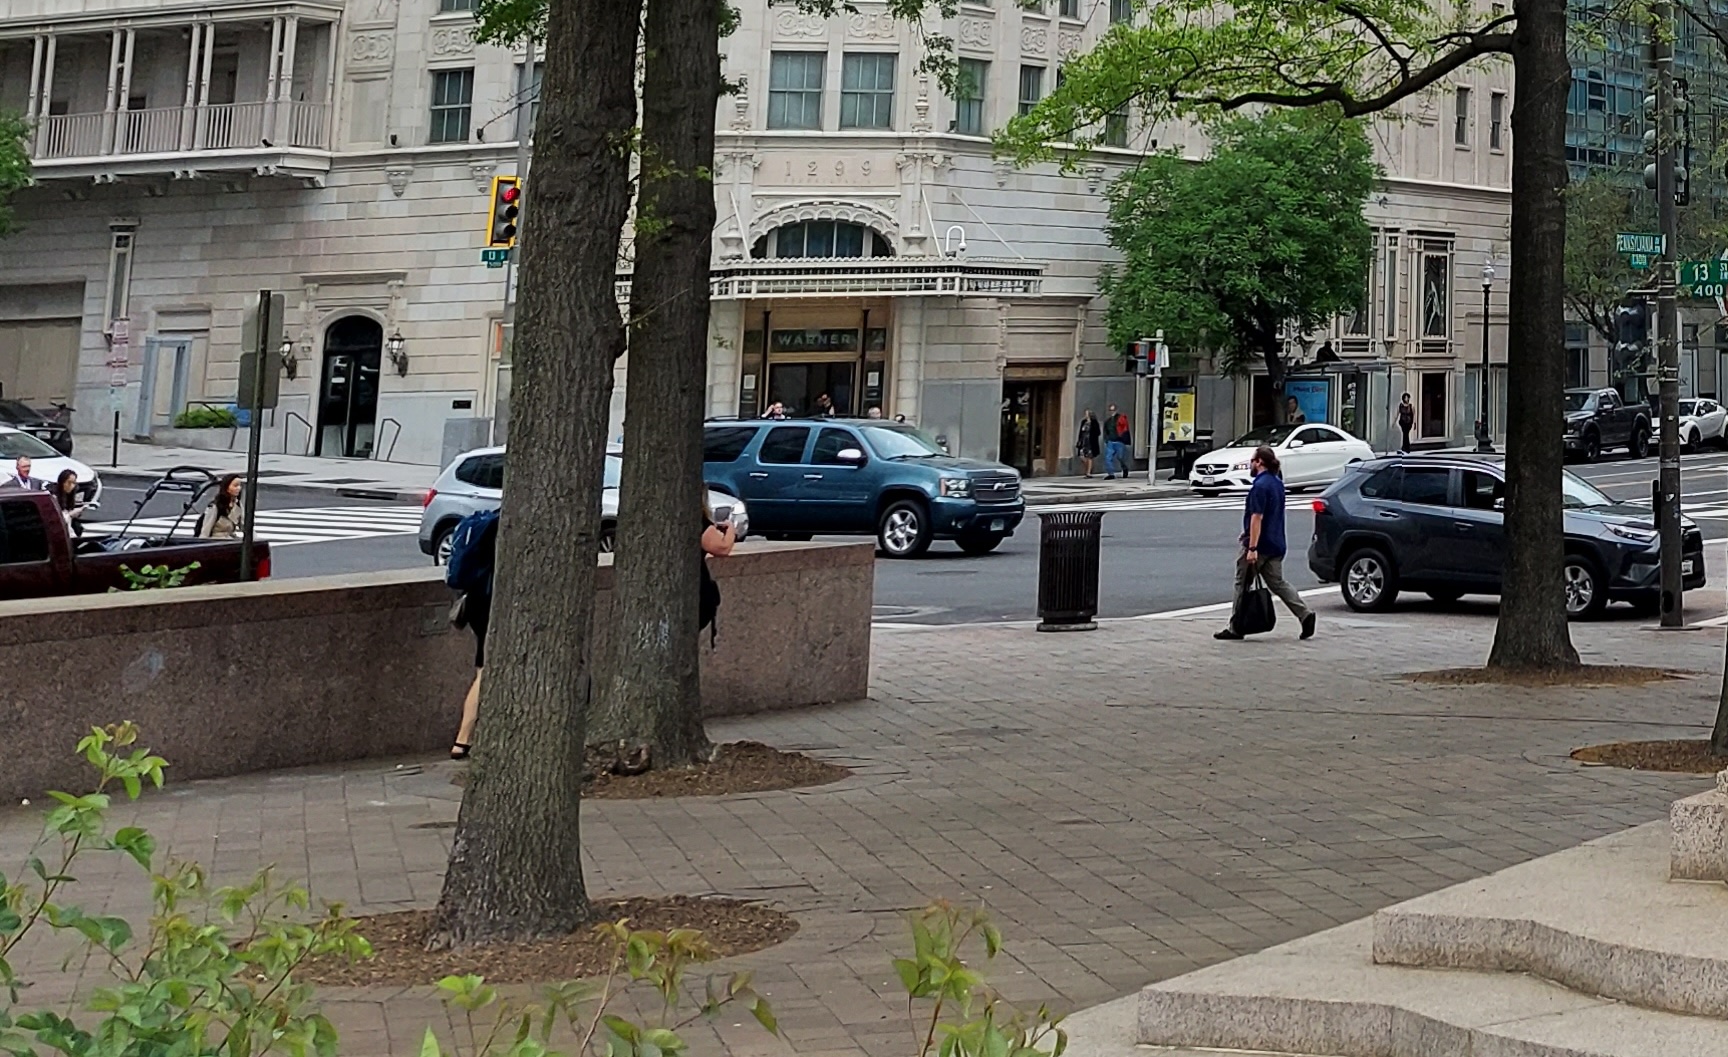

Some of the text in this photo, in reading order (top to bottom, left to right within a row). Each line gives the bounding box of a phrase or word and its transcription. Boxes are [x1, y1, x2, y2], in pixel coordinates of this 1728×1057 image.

[785, 159, 872, 177] 1299
[1616, 234, 1654, 252] PENNSYLVANIA
[1692, 263, 1728, 281] 13 ST
[1694, 284, 1724, 297] 400
[778, 333, 850, 346] WARNER
